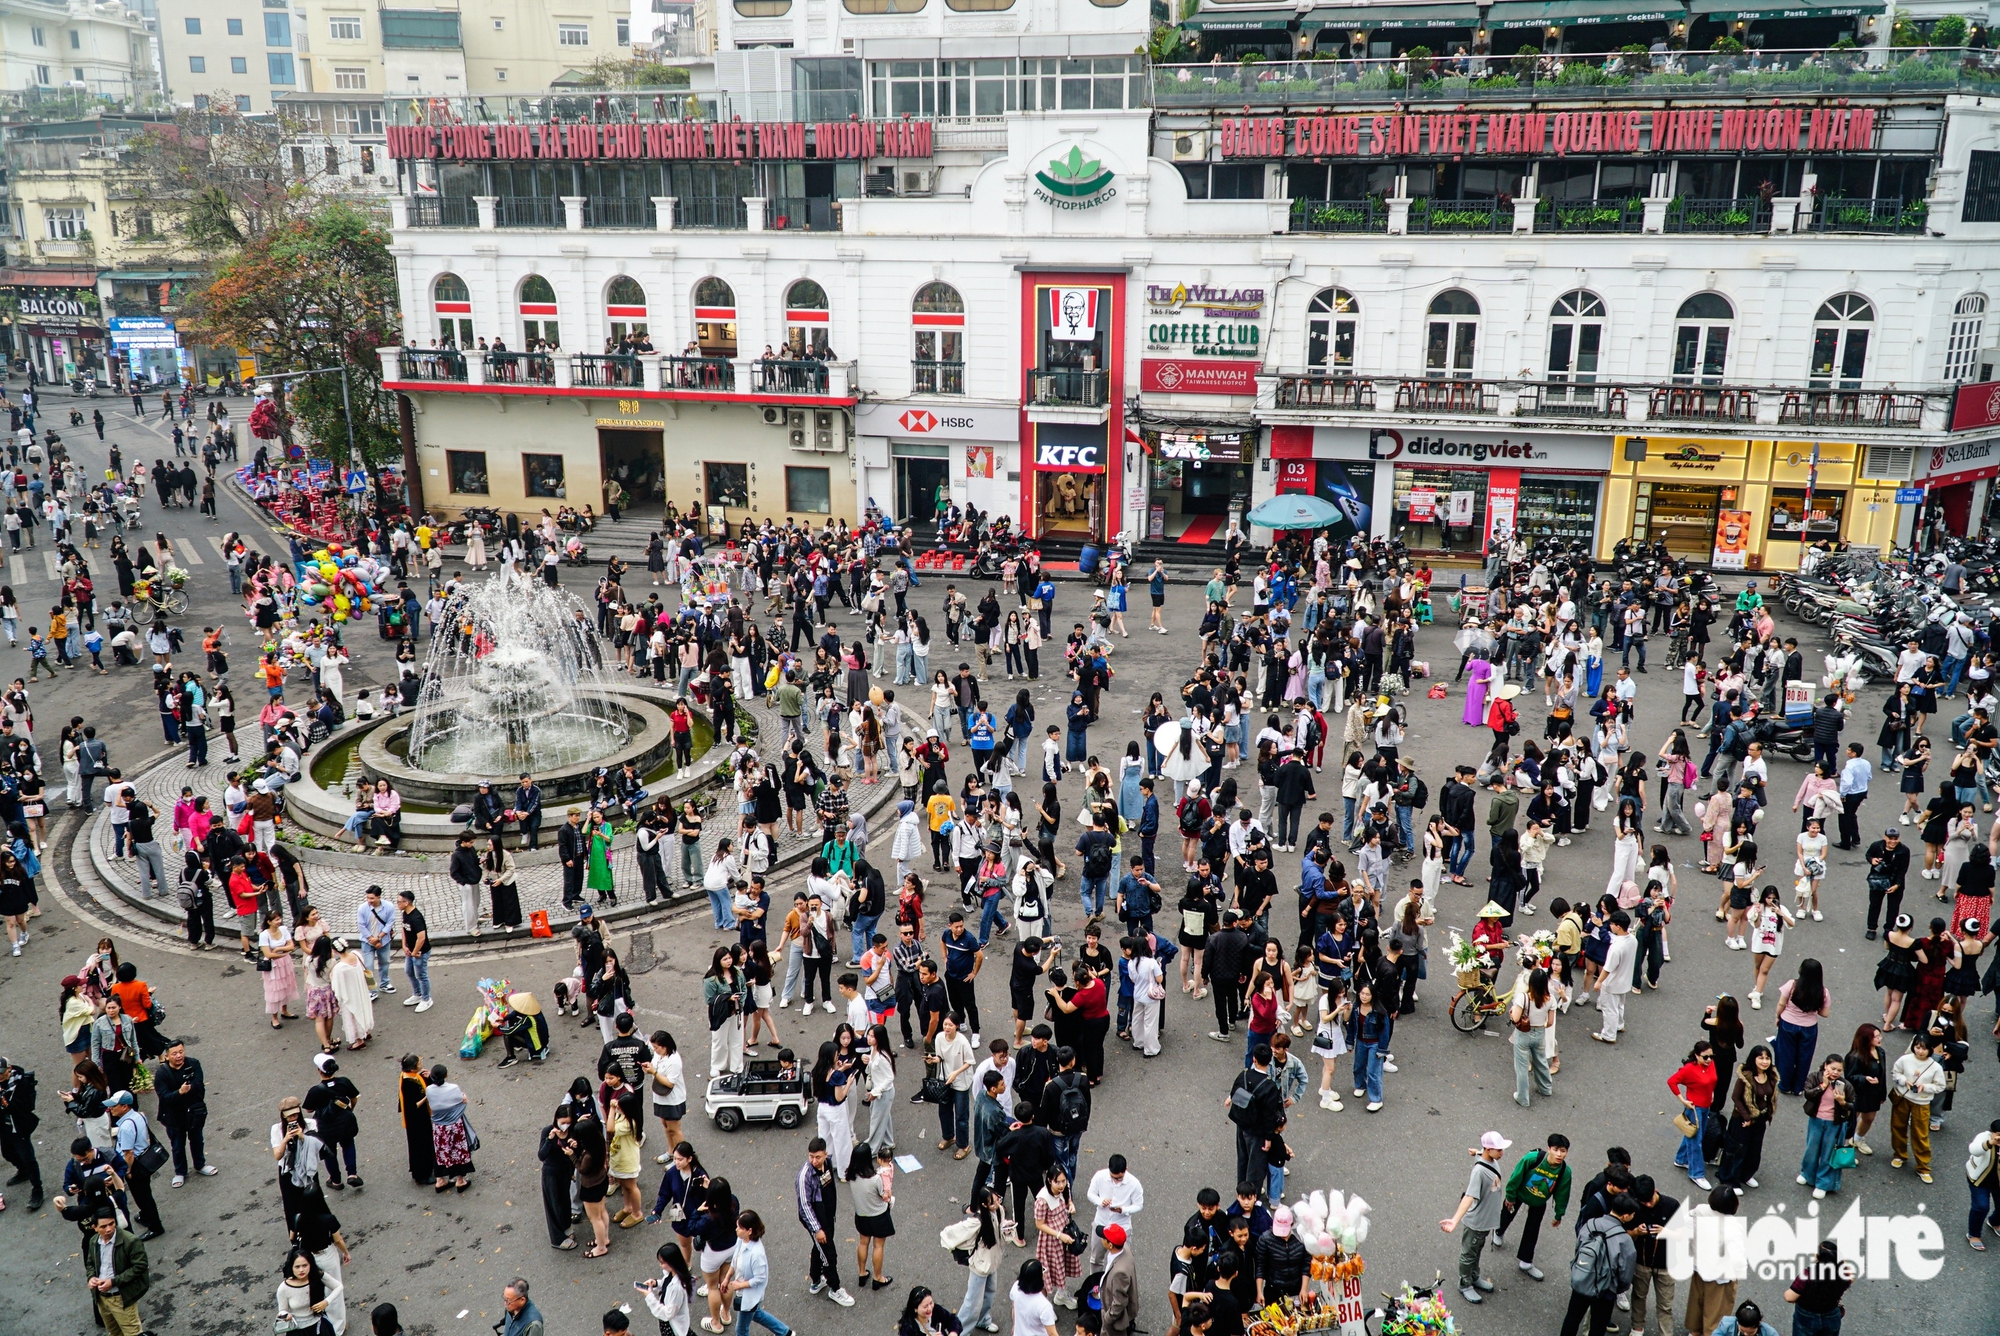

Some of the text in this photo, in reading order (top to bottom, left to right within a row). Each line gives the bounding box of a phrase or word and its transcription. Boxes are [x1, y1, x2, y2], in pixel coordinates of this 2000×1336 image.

[1577, 12, 1665, 24] Beers Cocktails
[1784, 10, 1808, 18] Pasta
[1831, 8, 1862, 16] Burger
[1245, 21, 1262, 29] food
[1325, 19, 1456, 28] Breakfast Steak Salmon
[1504, 19, 1551, 29] Eggs Coffee
[1221, 98, 1875, 164] ĐẢNG CỘNG SẢN VIỆT NAM QUANG VINH MUÔN NĂM
[441, 117, 492, 167] CỘNG
[713, 114, 754, 167] VIỆT
[759, 122, 805, 159] NAM
[815, 113, 877, 159] MUÔN
[885, 112, 932, 159] NĂM
[1033, 187, 1117, 211] PHYTOPHARCO
[20, 299, 87, 316] BALCONY
[1204, 308, 1260, 319] Restaurants
[118, 320, 166, 329] vinaphone
[1149, 323, 1260, 345] COFFEE CLUB
[1219, 345, 1259, 357] Restaurant
[1186, 369, 1247, 380] MANWAH
[941, 417, 974, 428] HSBC
[1038, 445, 1098, 466] KFC
[1946, 441, 1992, 464] SeABank
[1287, 462, 1306, 475] 03
[47, 505, 53, 514] 7
